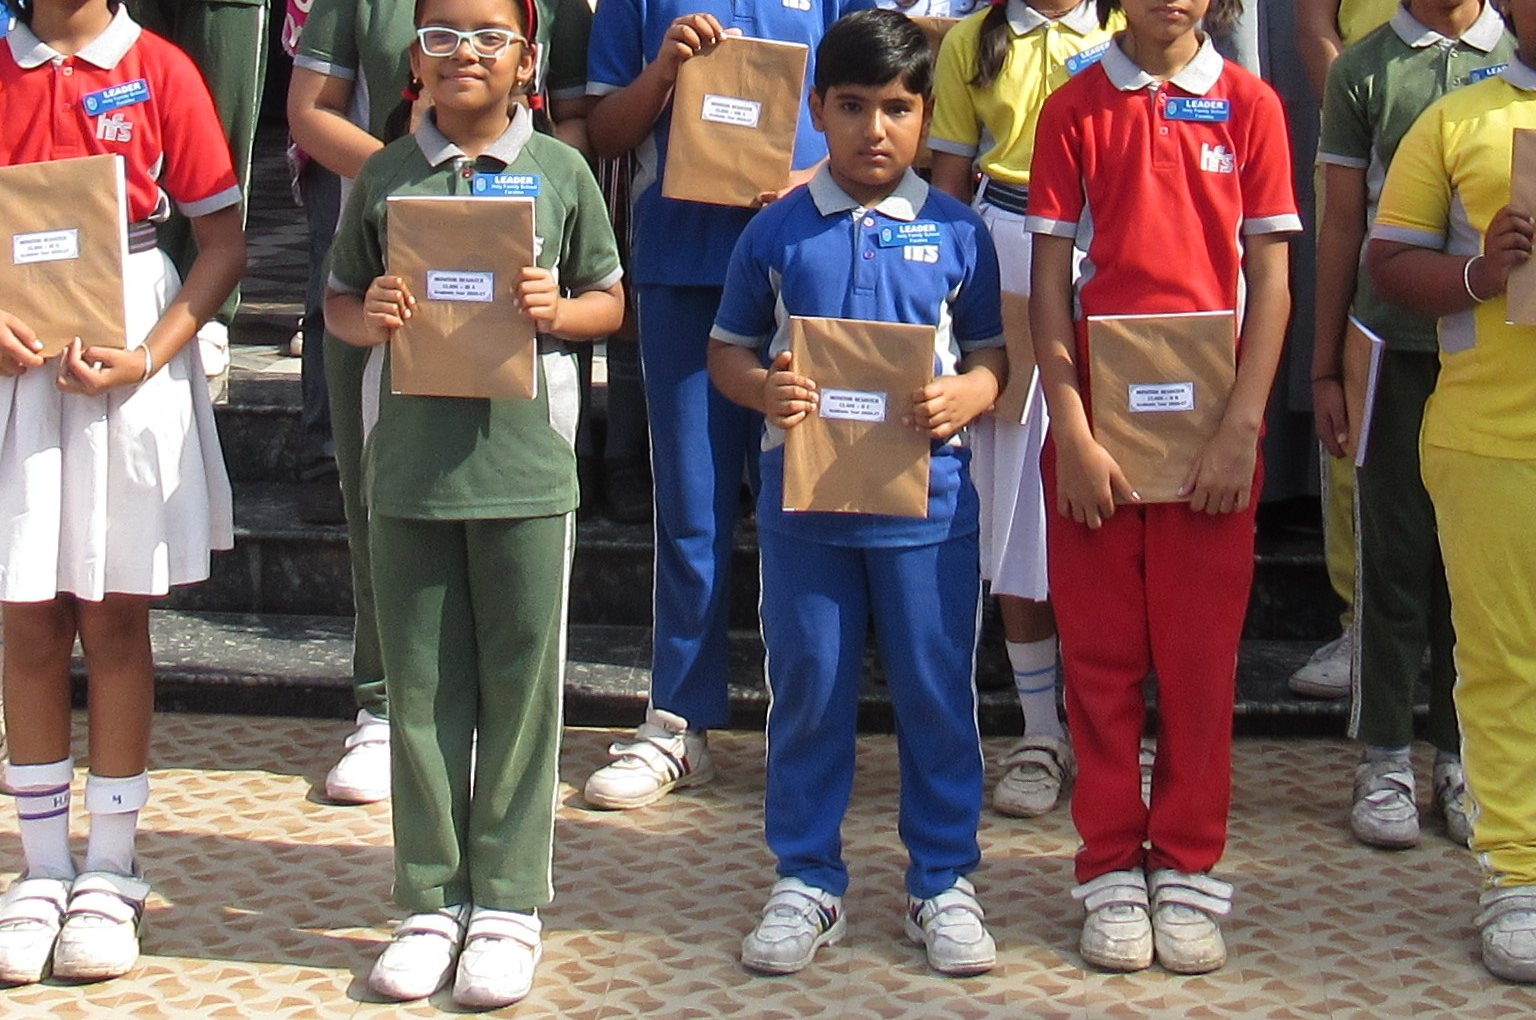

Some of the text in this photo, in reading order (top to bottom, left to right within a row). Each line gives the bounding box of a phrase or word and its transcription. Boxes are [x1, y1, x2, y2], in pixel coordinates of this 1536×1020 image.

[1079, 42, 1110, 59] LEADER
[102, 81, 142, 98] LEADER
[1185, 99, 1224, 109] LEADER
[95, 112, 133, 143] hfs
[1199, 142, 1234, 173] hfs
[494, 175, 534, 185] LEADER
[899, 224, 936, 233] LEADER
